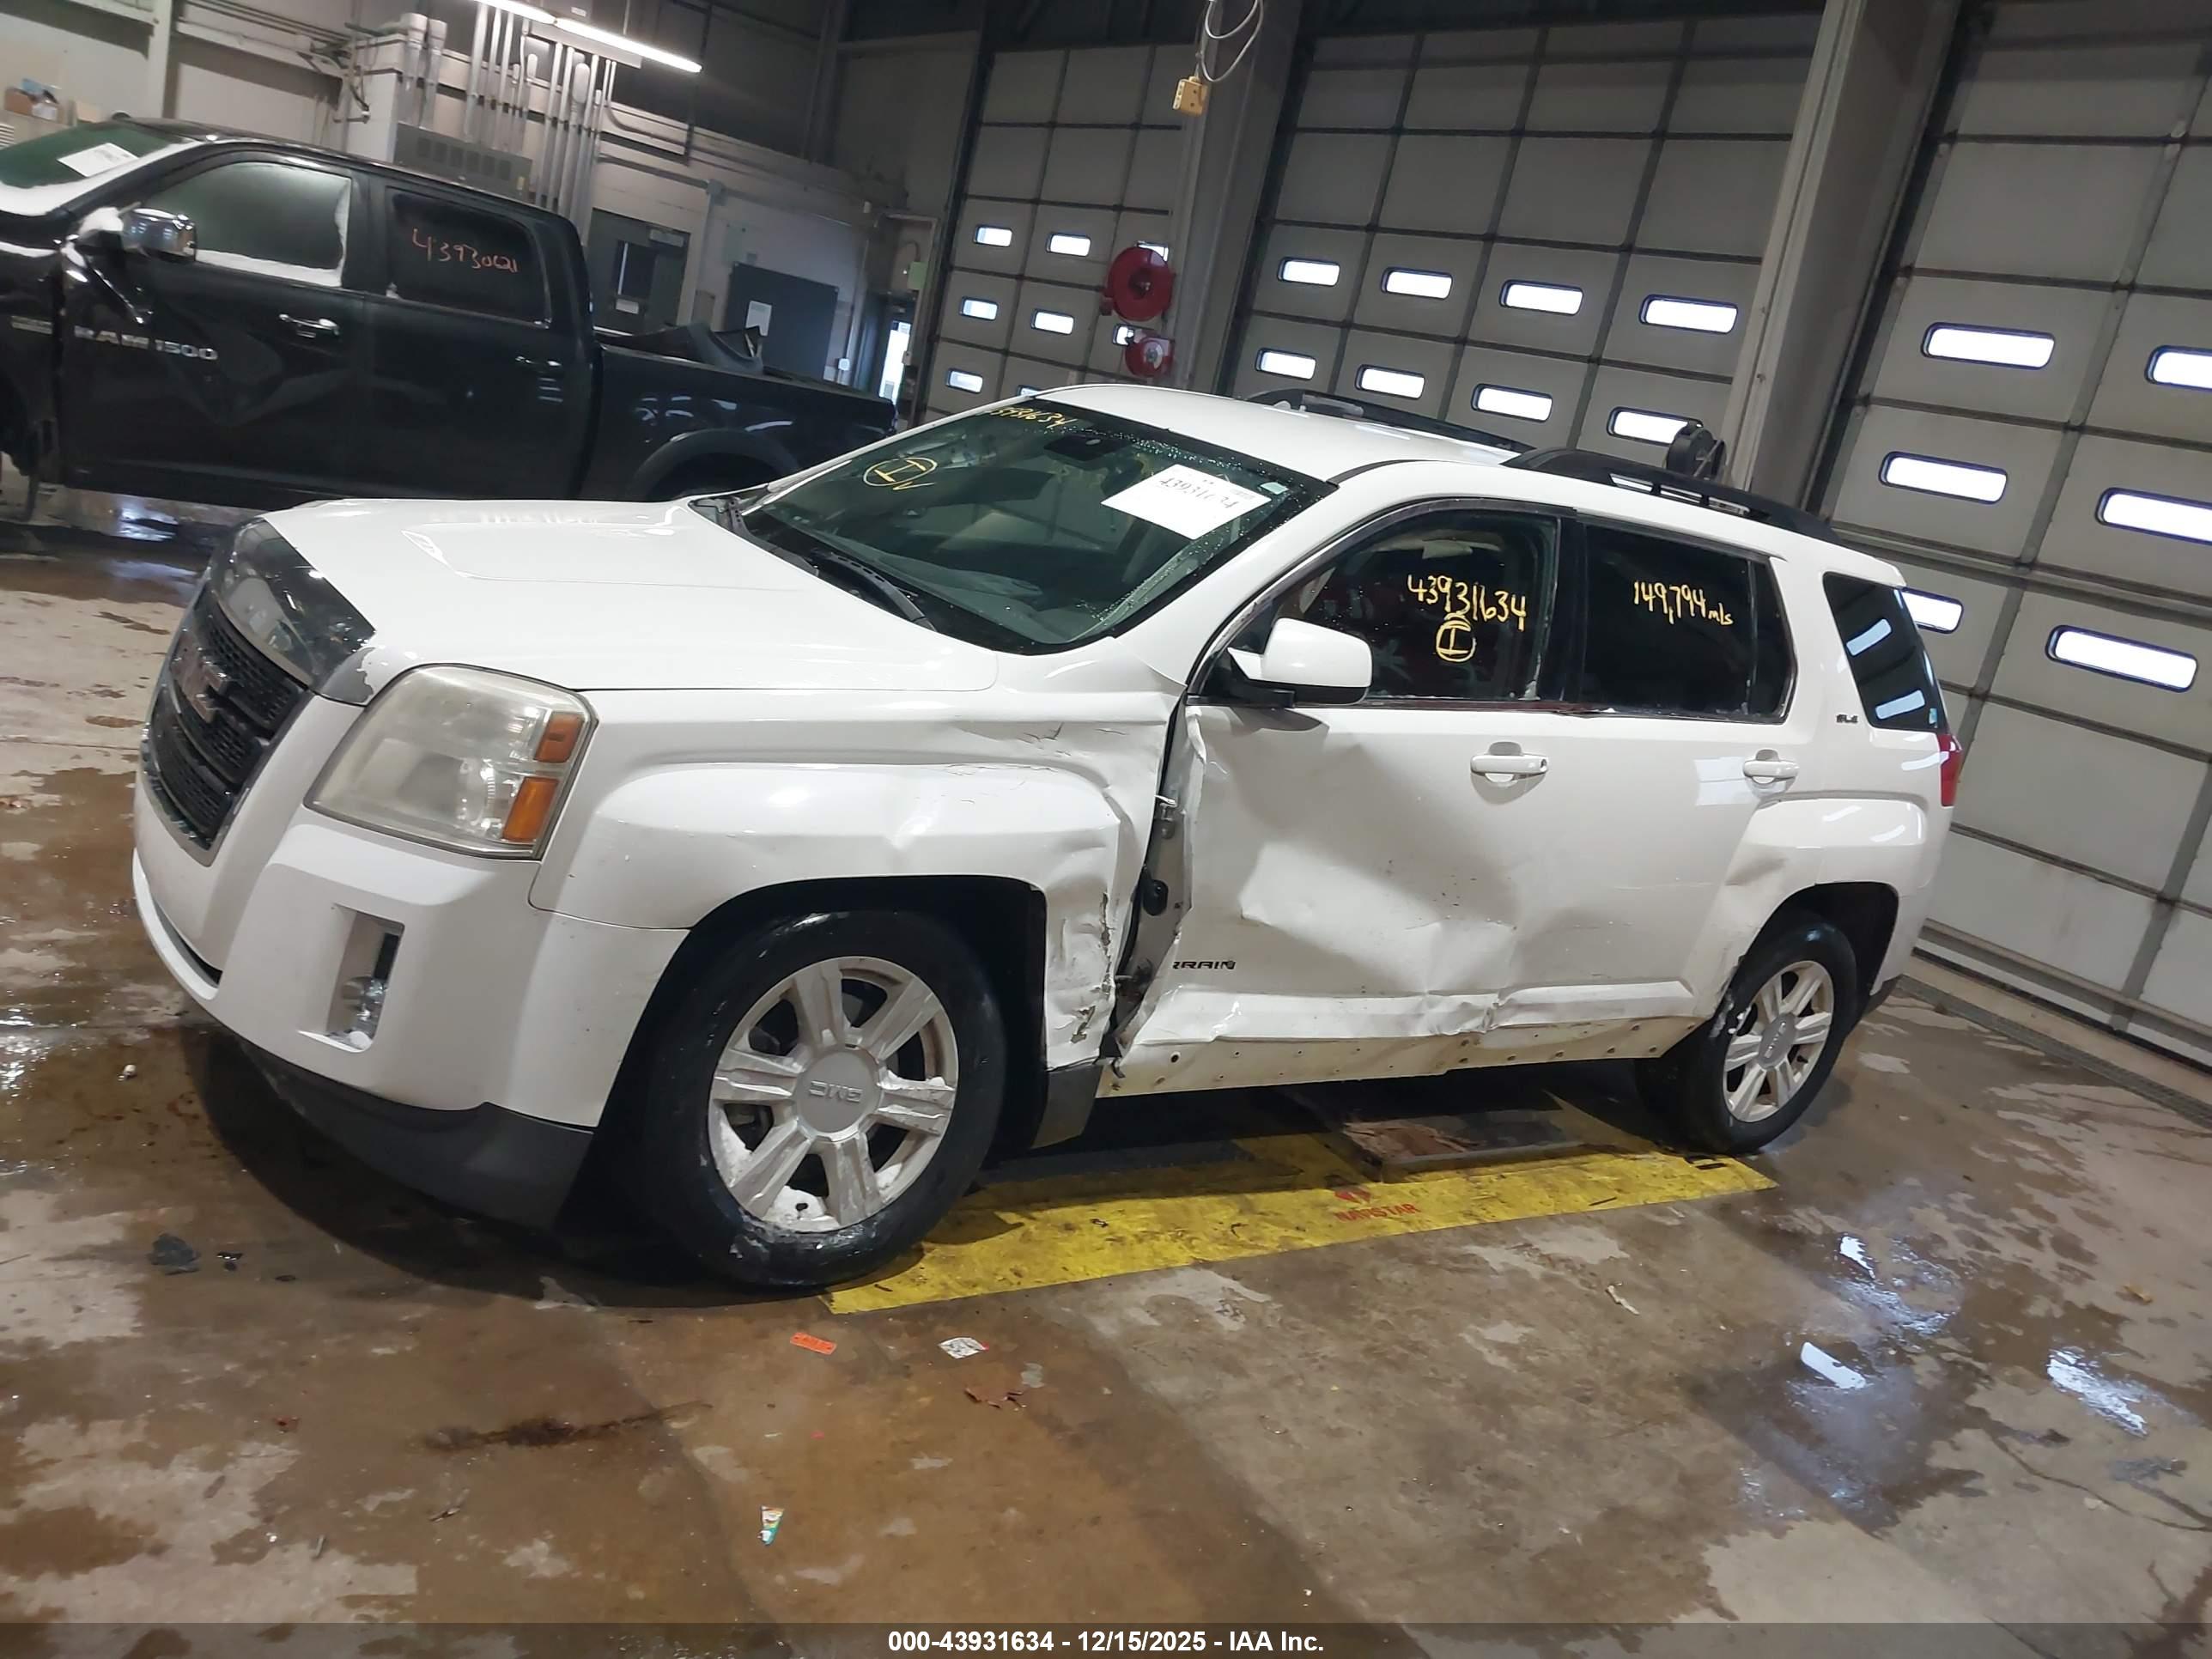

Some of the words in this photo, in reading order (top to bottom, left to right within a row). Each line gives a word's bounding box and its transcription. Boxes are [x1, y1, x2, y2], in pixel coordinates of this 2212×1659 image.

[155, 338, 218, 360] 1500
[990, 406, 1078, 428] 3931634
[1407, 574, 1526, 632] 43931634
[1633, 580, 1706, 624] 149,794
